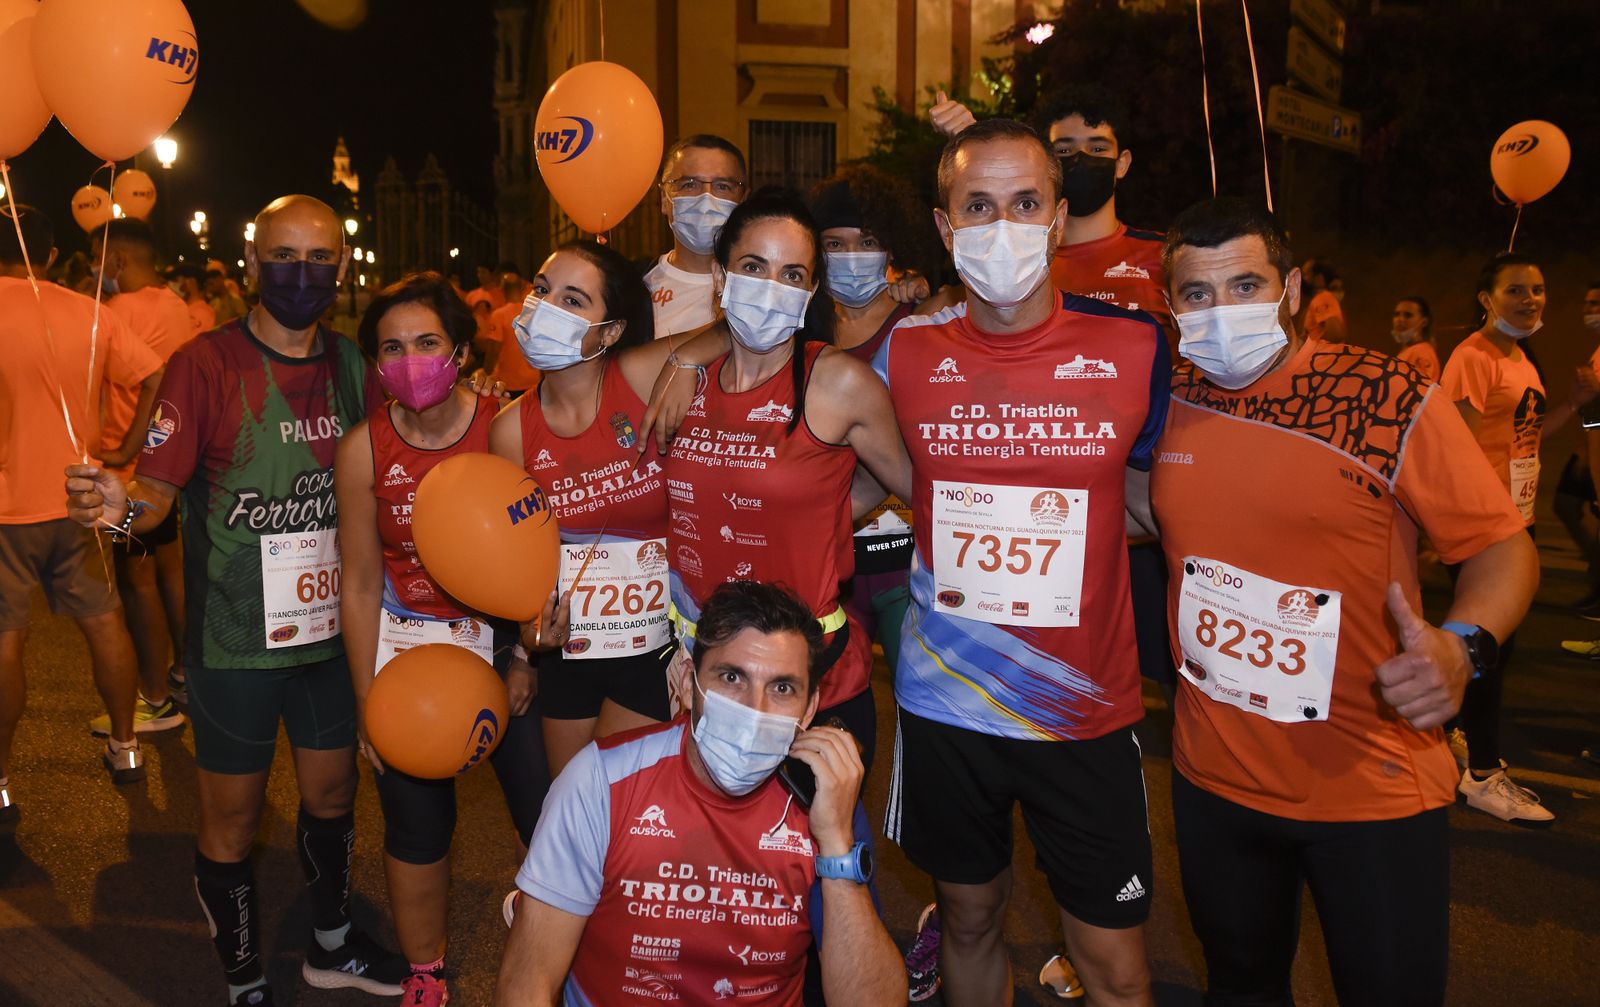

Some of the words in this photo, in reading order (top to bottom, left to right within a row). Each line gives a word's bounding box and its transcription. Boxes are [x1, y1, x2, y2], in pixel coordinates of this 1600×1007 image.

[950, 404, 991, 419] C.D.
[999, 403, 1078, 418] Triatlón
[280, 415, 344, 444] PALOS
[690, 427, 711, 439] C.D.
[716, 430, 757, 443] Triatlón
[919, 422, 1117, 440] TRIOLALLA
[672, 437, 776, 459] TRIOLALLA
[928, 442, 959, 456] CHC
[1030, 442, 1105, 456] Tentudia
[671, 449, 687, 460] CHC
[725, 458, 767, 470] Tentudia
[548, 460, 663, 508] RIOLALLA
[552, 477, 577, 492] C.D.
[581, 459, 631, 484] Triatlón
[607, 479, 661, 505] Tentudia
[737, 497, 762, 507] ROYSE
[975, 524, 1004, 532] NOCTURNA
[866, 543, 890, 552] NEVER
[891, 538, 909, 548] STOP
[953, 531, 1061, 576] 7357
[577, 580, 665, 617] 7262
[268, 608, 308, 619] FRANCISCO
[309, 605, 326, 615] JAVIER
[1221, 605, 1250, 620] NOCTURNA
[1250, 616, 1260, 625] DEL
[570, 622, 606, 631] CANDELA
[608, 619, 646, 630] DELGADO
[1196, 608, 1307, 676] 8233
[658, 862, 698, 880] C.D.
[707, 866, 778, 889] Triatlón
[620, 879, 803, 912] TRIOLALLA
[628, 901, 662, 918] CHC
[732, 910, 798, 927] Tentudia
[632, 934, 681, 948] POZOS
[631, 945, 679, 958] CARRILLO
[752, 951, 787, 961] ROYSE
